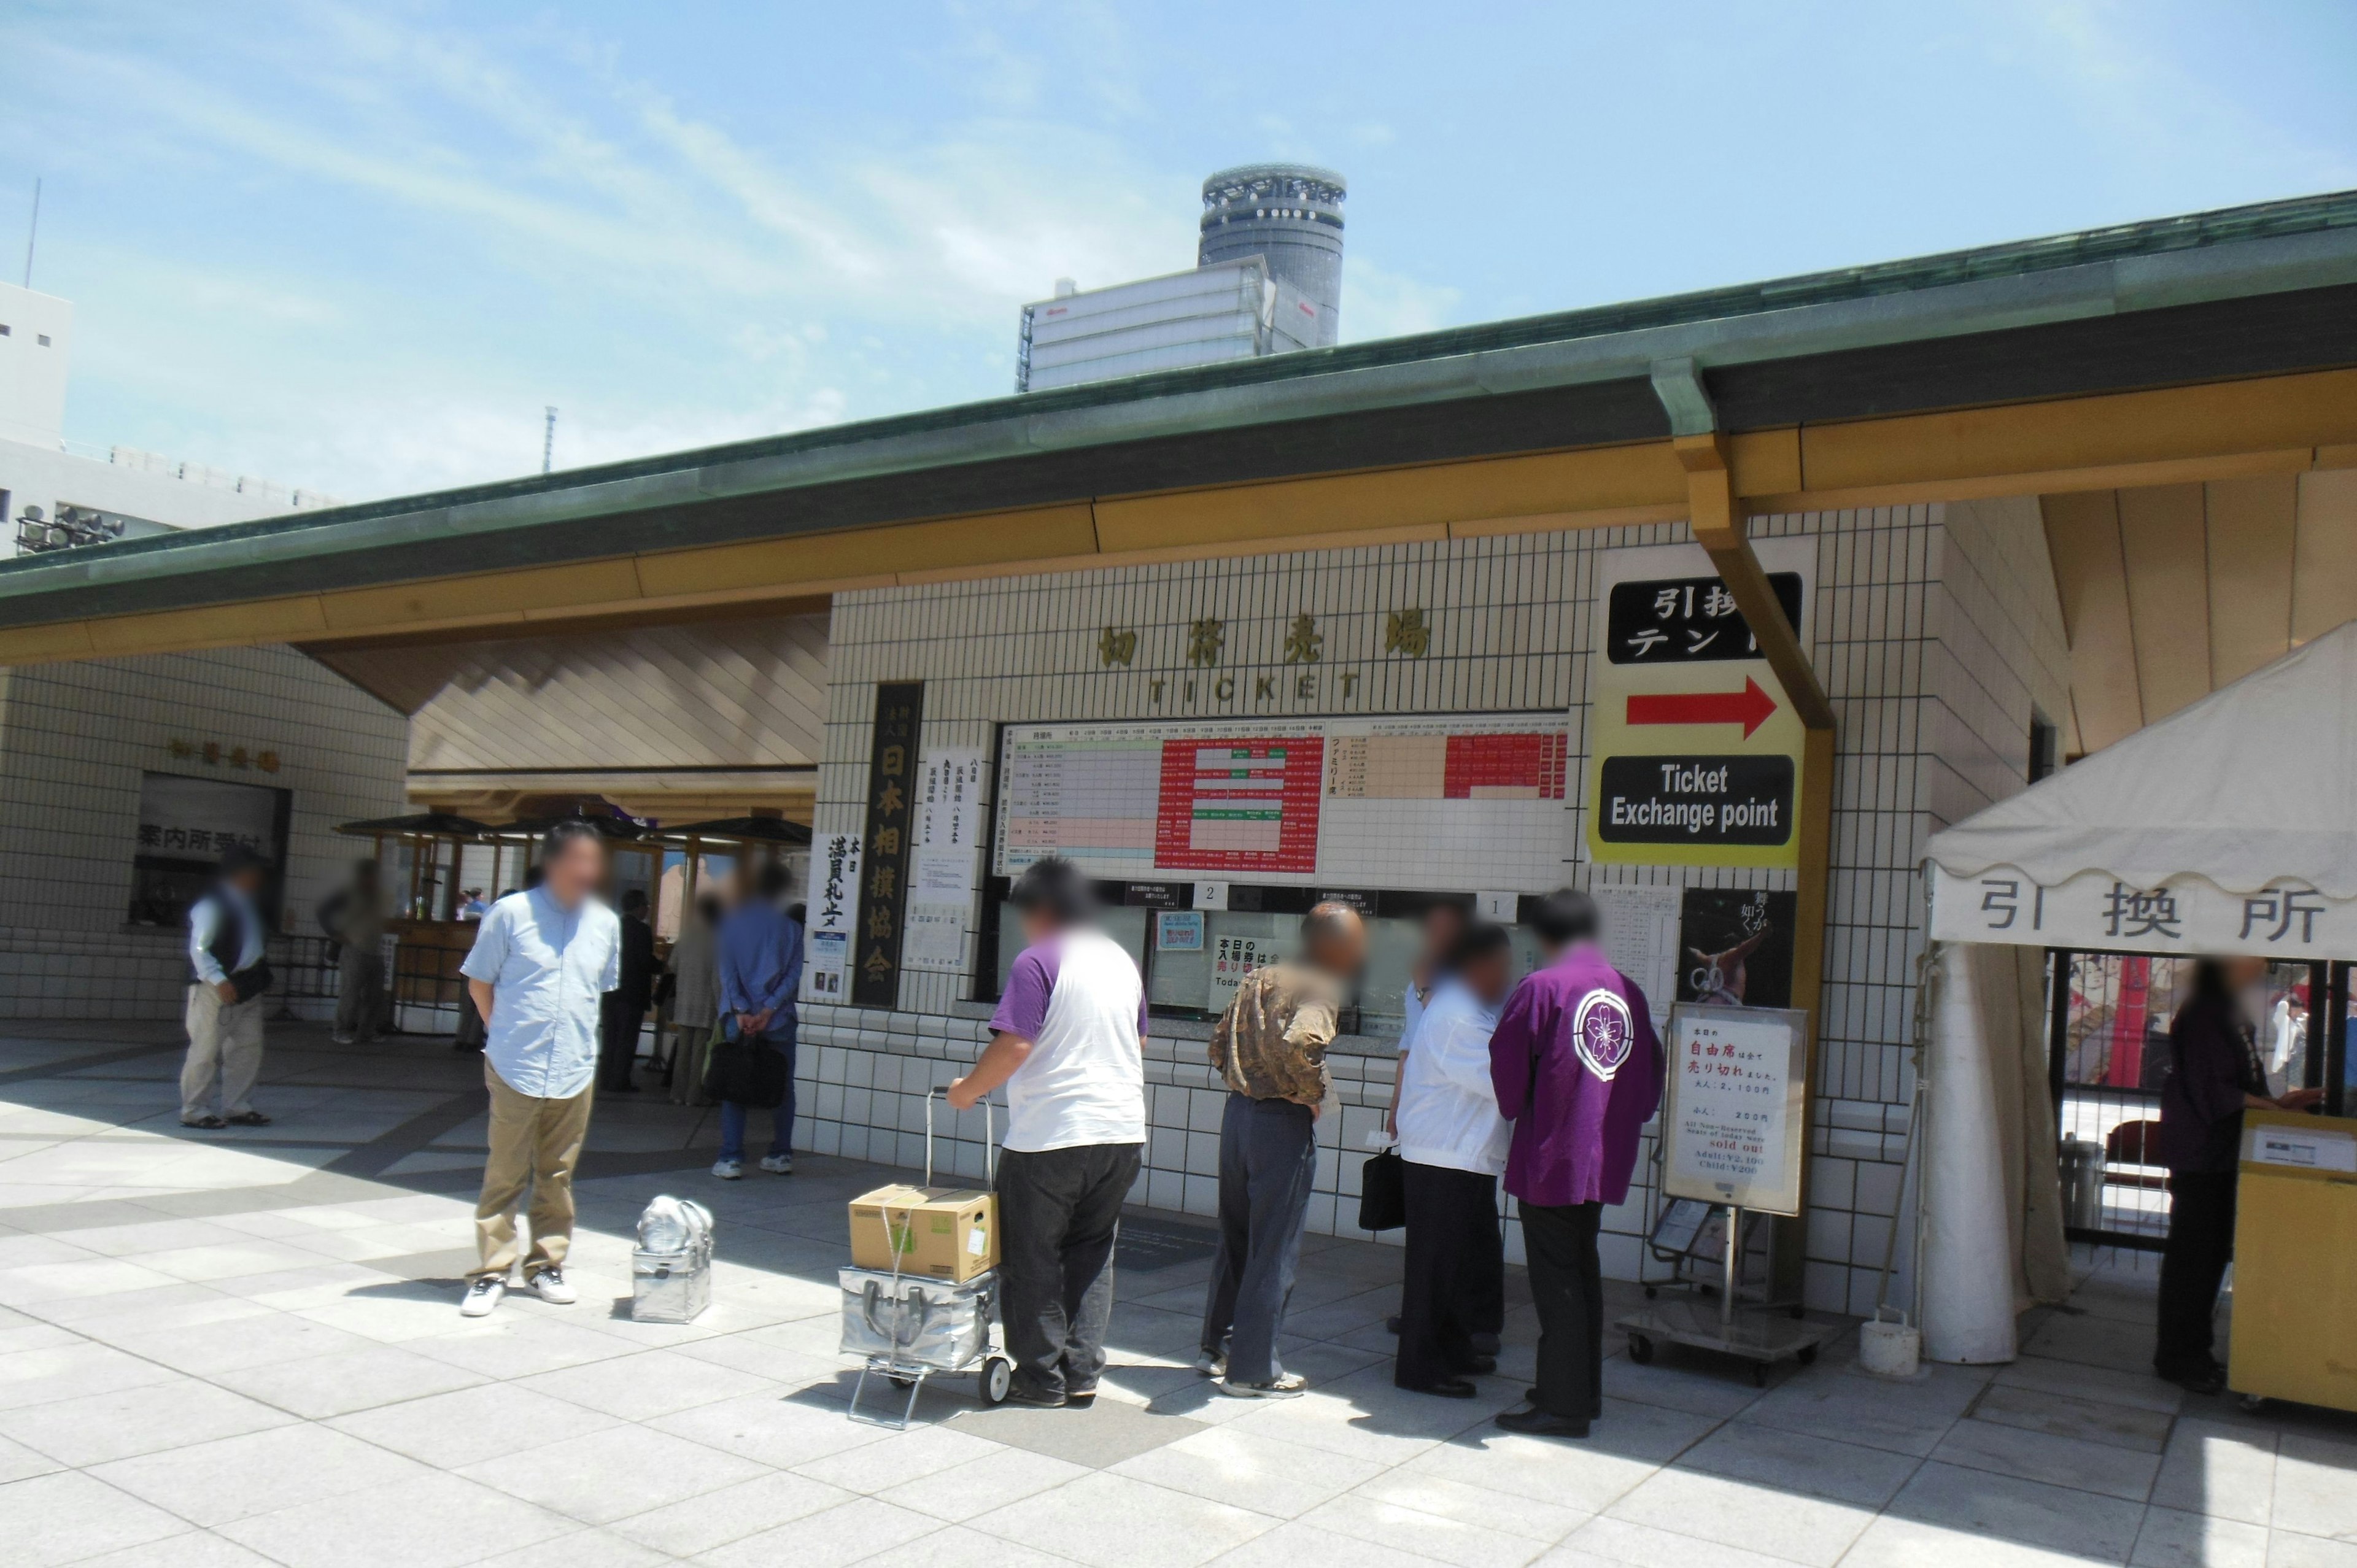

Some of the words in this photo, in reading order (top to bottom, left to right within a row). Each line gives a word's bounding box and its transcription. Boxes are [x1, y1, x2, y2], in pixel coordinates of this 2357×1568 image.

[1150, 673, 1358, 703] TICKET
[1662, 763, 1728, 794] Ticket
[1611, 796, 1715, 833] Exchange
[1721, 797, 1778, 833] point
[849, 836, 861, 873] 本日
[863, 744, 905, 983] 日本相撲協会
[1206, 887, 1214, 900] 2
[1492, 900, 1498, 914] 1
[1980, 879, 2326, 943] 引換所
[1220, 938, 1255, 951] 本日の
[1216, 977, 1240, 987] Toda
[1693, 1028, 1718, 1037] 本日の
[1709, 1140, 1736, 1151] sold
[1743, 1144, 1763, 1154] out
